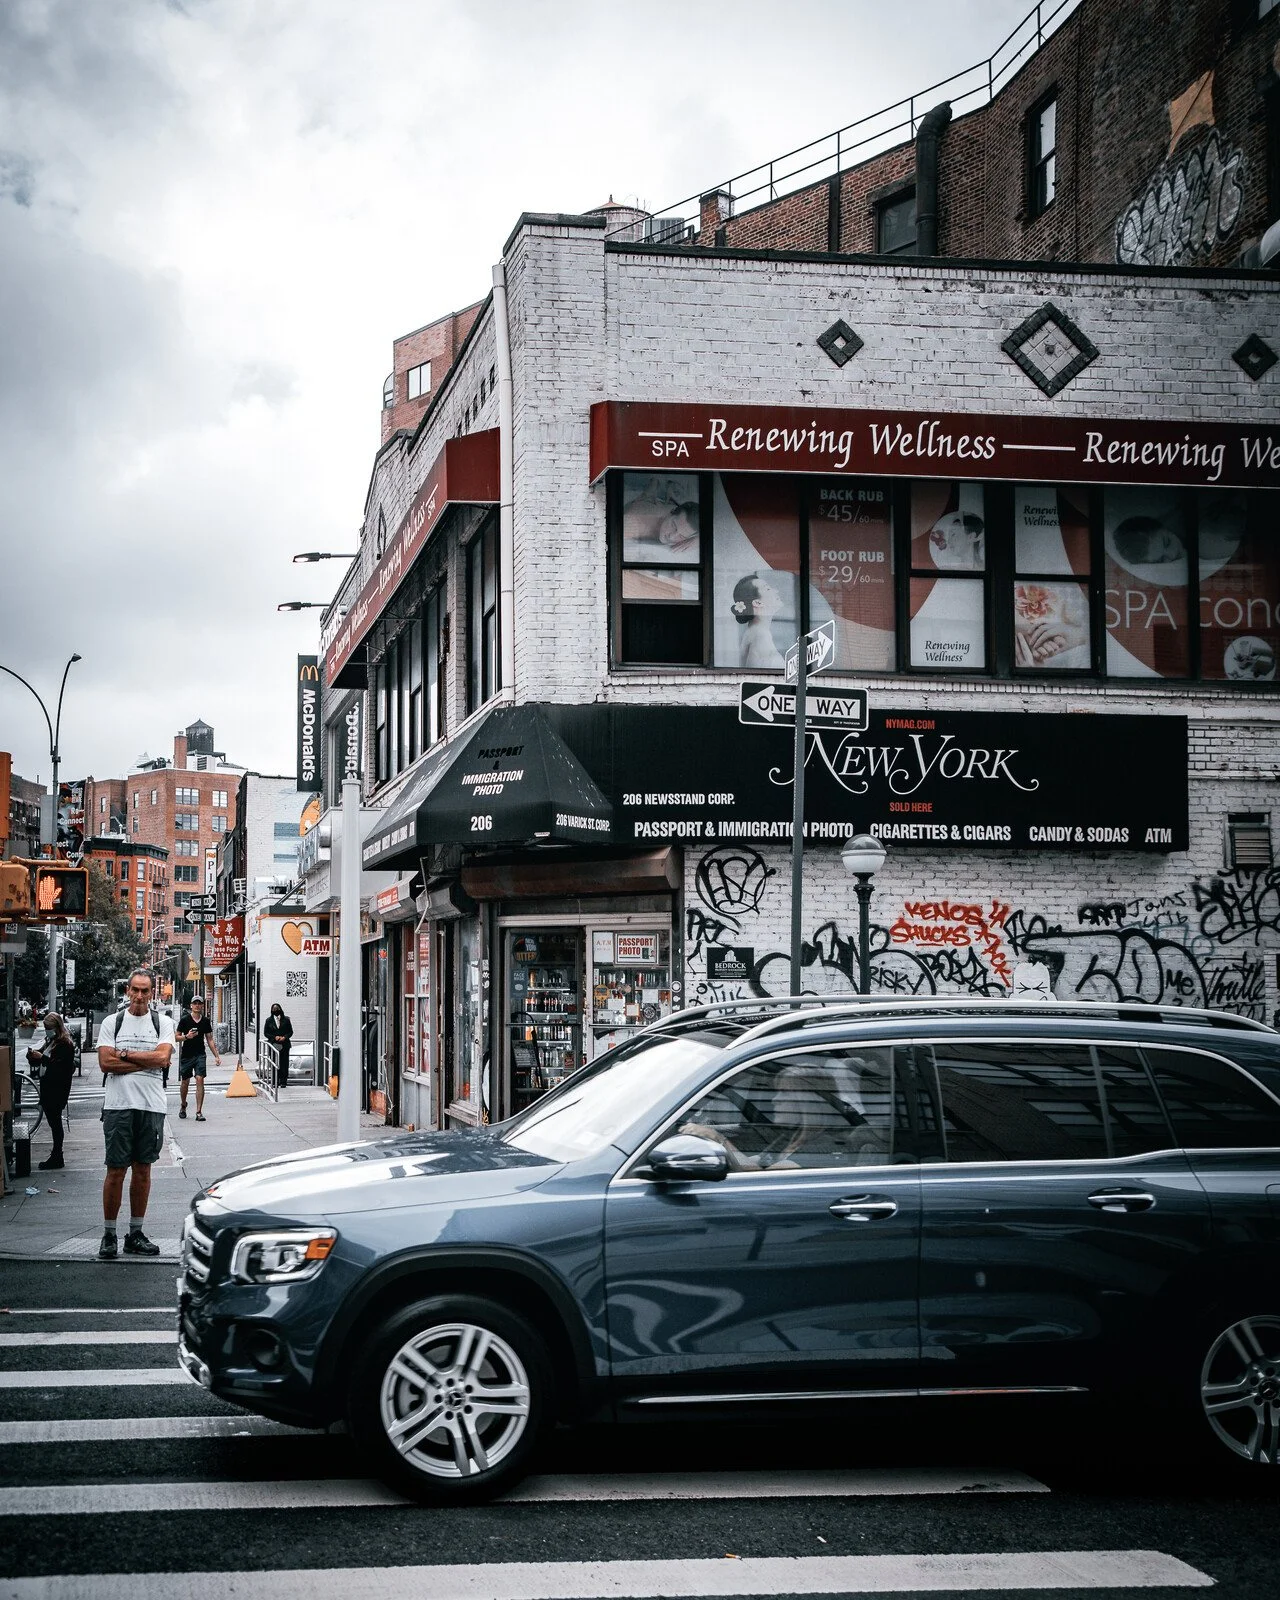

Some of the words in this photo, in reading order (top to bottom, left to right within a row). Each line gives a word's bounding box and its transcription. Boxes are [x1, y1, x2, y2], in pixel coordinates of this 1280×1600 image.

[652, 440, 689, 457] SPA
[705, 418, 854, 468] Renewing
[869, 420, 996, 460] Wellness
[1082, 432, 1226, 481] Renewing
[820, 489, 853, 500] BACK
[858, 490, 884, 502] RUB
[1023, 505, 1060, 516] Renewi
[821, 550, 854, 561] FOOT
[858, 551, 885, 562] RUB
[1105, 590, 1177, 630] SPA
[807, 638, 827, 664] WAY
[925, 640, 970, 654] Renewing
[925, 651, 963, 662] Wellness
[757, 695, 795, 712] ONE
[816, 699, 856, 716] WAY
[885, 718, 936, 730] NYMAG.COM
[302, 688, 316, 782] McDonald's
[477, 744, 525, 760] PASSPORT
[492, 760, 501, 770] &
[769, 732, 905, 794] NEW
[888, 734, 1039, 795] YORK
[461, 769, 524, 786] IMMIGRATION
[472, 784, 504, 797] PHOTO
[622, 793, 642, 805] 206
[644, 793, 705, 805] NEWSSTAND
[707, 793, 735, 805] CORP.
[889, 802, 910, 812] SOLD
[911, 802, 933, 813] HERE
[470, 815, 493, 832] 206
[556, 813, 568, 827] 206
[567, 814, 588, 829] VARICK
[634, 821, 703, 838] PASSPORT
[704, 822, 716, 837] &
[811, 822, 854, 838] PHOTO
[869, 823, 948, 841] CIGARETTES
[951, 824, 961, 840] &
[963, 824, 1012, 841] CIGARS
[1029, 825, 1073, 843] CANDY
[1074, 827, 1084, 842] &
[1087, 826, 1130, 843] SODAS
[1144, 827, 1172, 844] ATM
[224, 936, 239, 945] Wok
[303, 939, 330, 951] ATM
[619, 937, 654, 947] PASSPORT
[619, 947, 641, 956] PHOTO
